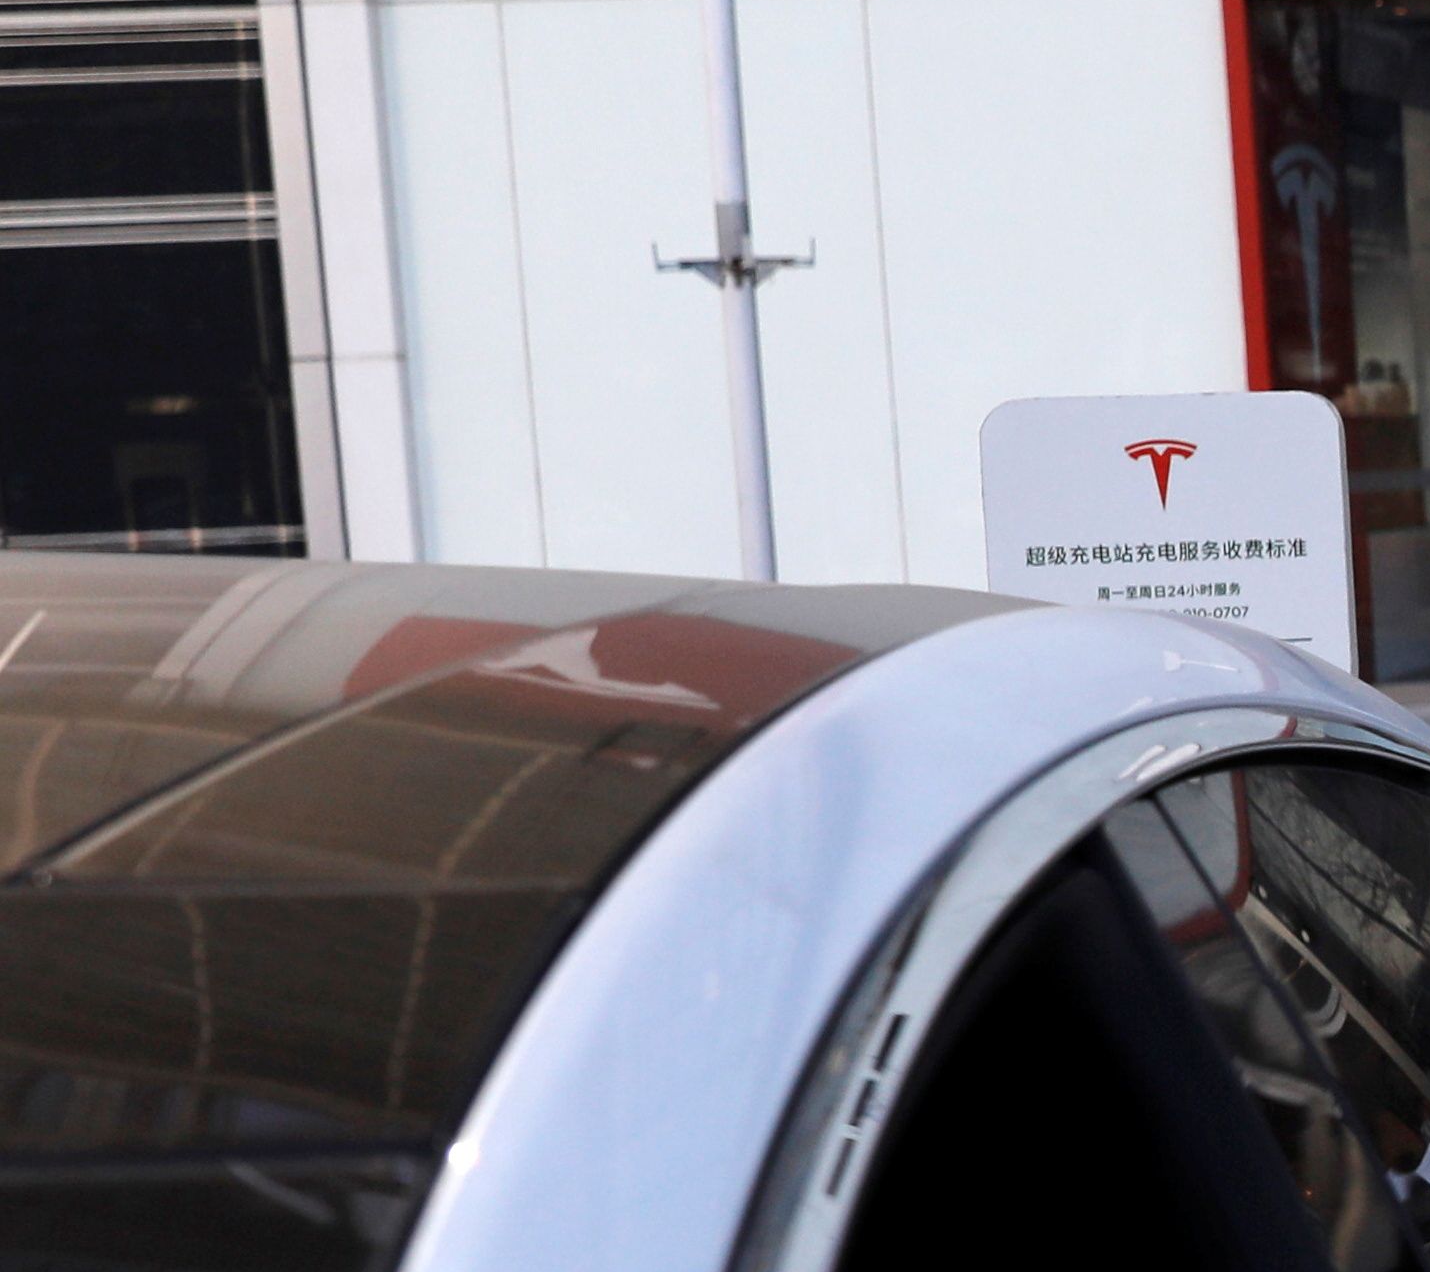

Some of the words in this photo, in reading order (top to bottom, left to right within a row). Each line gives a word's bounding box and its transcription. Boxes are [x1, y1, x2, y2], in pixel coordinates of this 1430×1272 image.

[1026, 538, 1307, 566] 超级充电站充电服务收费标准
[1097, 581, 1241, 601] 周一至周日24小时服务
